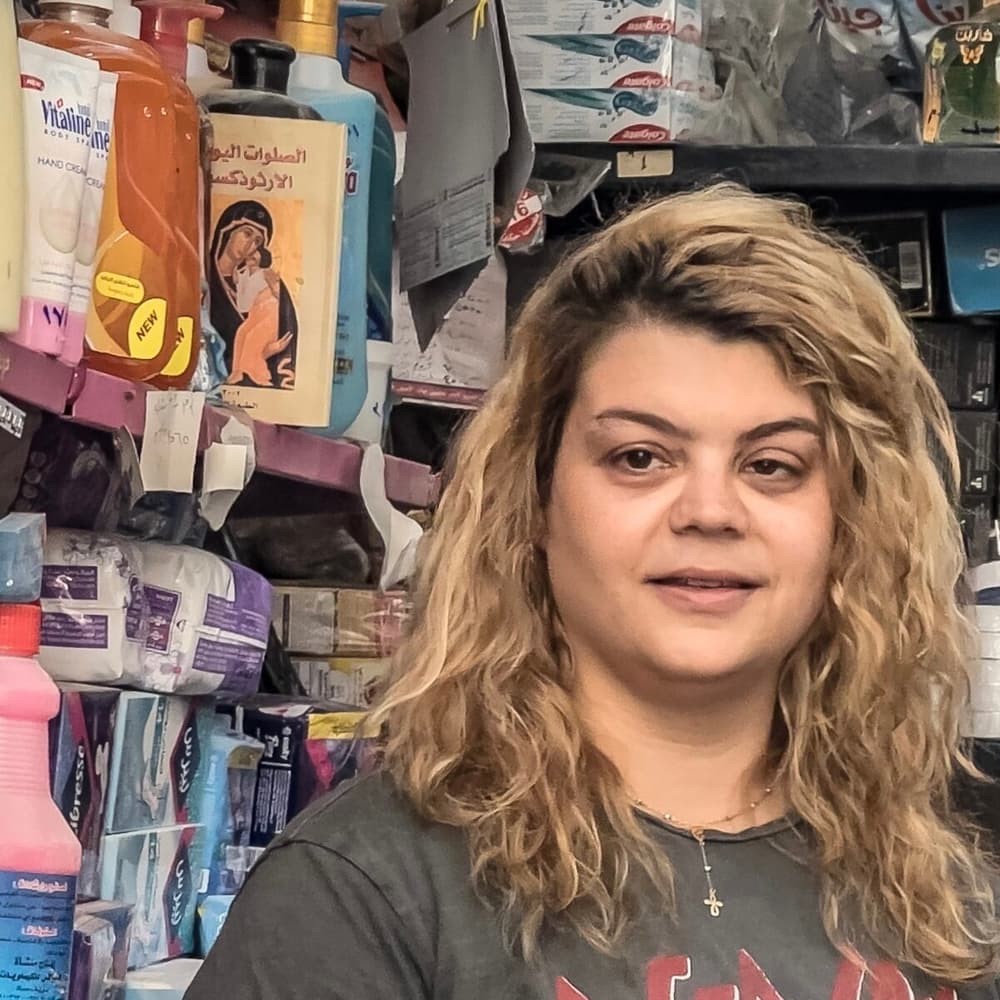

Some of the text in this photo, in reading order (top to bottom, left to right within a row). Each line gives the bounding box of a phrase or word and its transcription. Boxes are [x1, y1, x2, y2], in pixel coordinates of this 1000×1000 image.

[626, 19, 672, 33] Colgate
[622, 76, 669, 88] Colgate
[41, 99, 92, 138] Vitaline
[622, 129, 667, 142] Colgate
[243, 145, 306, 165] الصلوات
[38, 157, 64, 169] HAND
[136, 309, 158, 341] NEW
